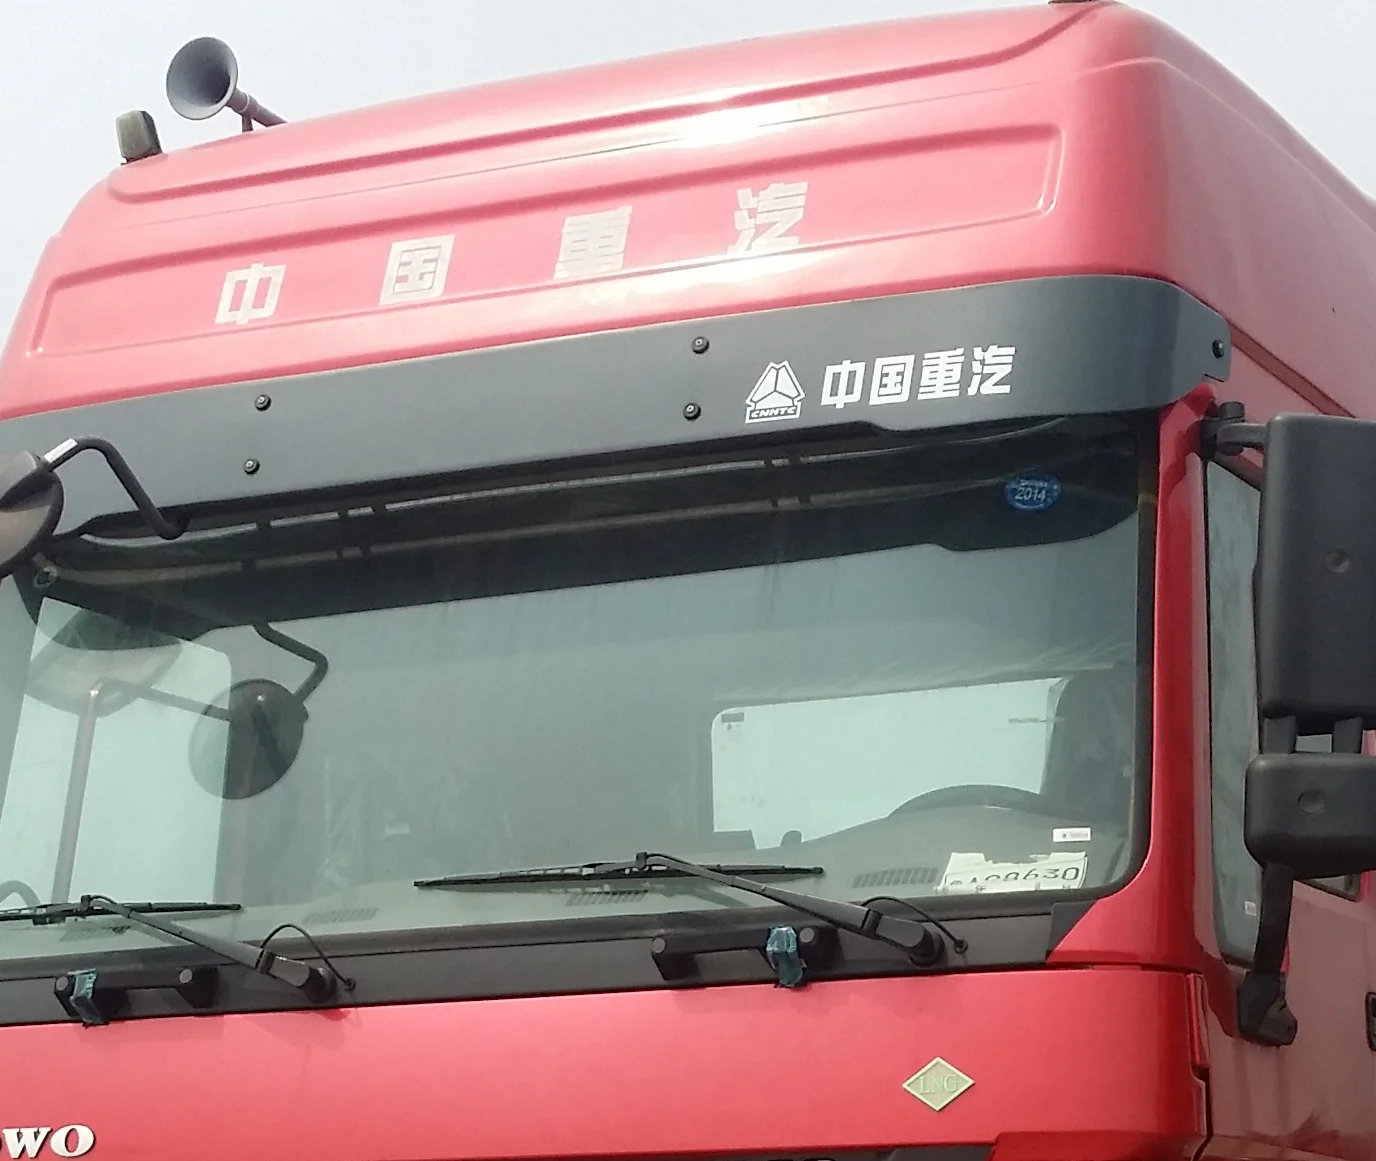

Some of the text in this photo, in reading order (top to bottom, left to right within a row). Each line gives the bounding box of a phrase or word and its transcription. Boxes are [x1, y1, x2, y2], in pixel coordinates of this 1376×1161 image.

[214, 180, 810, 326] 中国重汽
[821, 344, 1017, 409] 中国重汽
[1014, 486, 1047, 501] 2014
[919, 1074, 959, 1095] LNG
